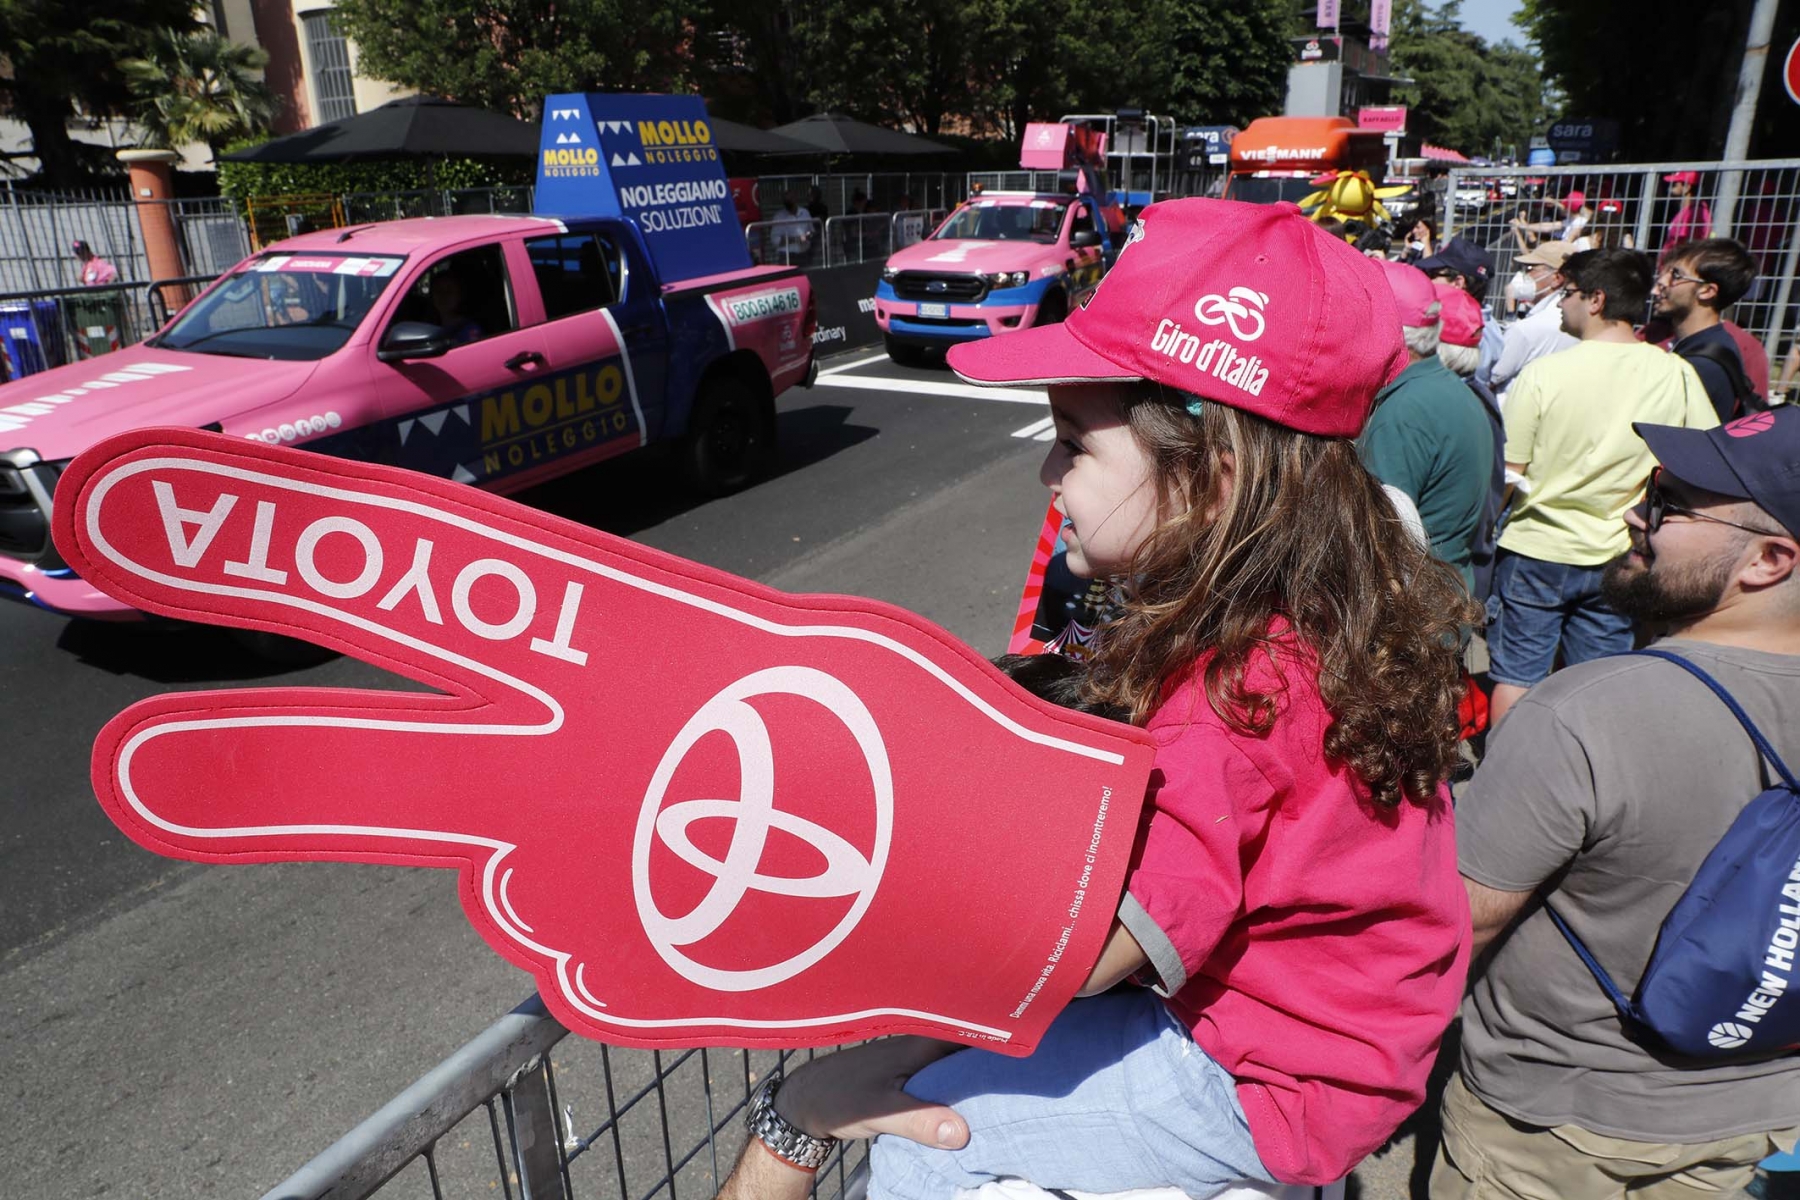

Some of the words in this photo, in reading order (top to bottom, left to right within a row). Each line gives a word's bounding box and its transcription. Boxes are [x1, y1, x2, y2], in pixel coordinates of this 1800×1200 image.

[637, 120, 711, 147] MOLLO
[1554, 124, 1593, 137] sara
[543, 148, 598, 166] MOLLO
[645, 148, 717, 165] NOLEGGIO
[544, 167, 600, 177] NOLEGGIO
[620, 179, 727, 208] NOLEGGIAMO
[640, 205, 723, 233] SOLUZIONI
[1151, 318, 1200, 364] Giro
[1195, 339, 1269, 397] d'Italia
[480, 364, 623, 442] MOLLO
[483, 411, 627, 474] NOLEGGIO
[151, 480, 589, 666] TOYOTA
[1086, 785, 1113, 854] incontreremo!
[1085, 854, 1095, 863] ci
[1077, 864, 1093, 888] dove
[1068, 889, 1085, 918] chissà
[1041, 963, 1056, 977] vita.
[1031, 976, 1047, 997] nuova
[1735, 970, 1788, 1023] NEW
